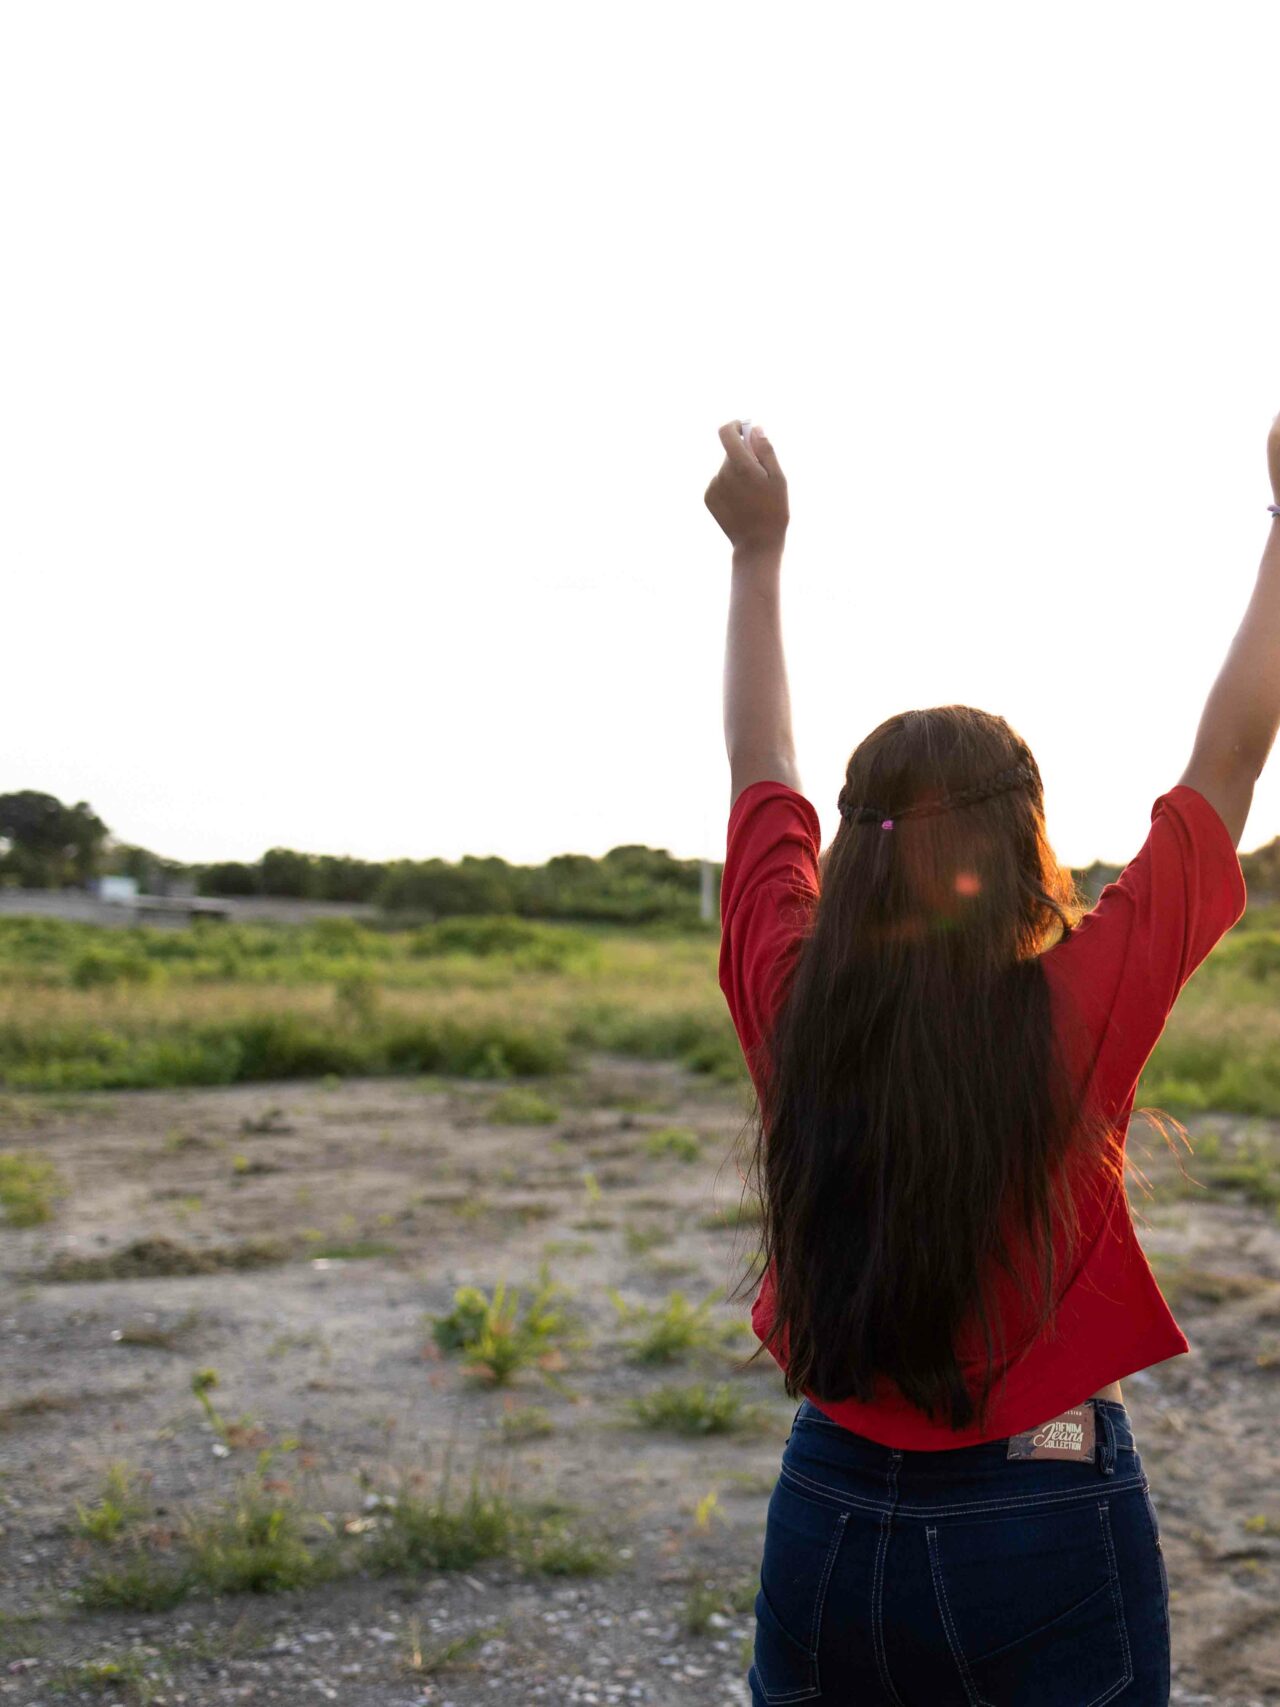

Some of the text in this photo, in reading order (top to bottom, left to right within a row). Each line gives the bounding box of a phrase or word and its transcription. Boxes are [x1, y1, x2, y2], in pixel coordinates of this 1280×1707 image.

[1055, 1422, 1082, 1433] DENIM
[1033, 1423, 1084, 1447] Jeans
[1044, 1440, 1082, 1451] COLLECTION
